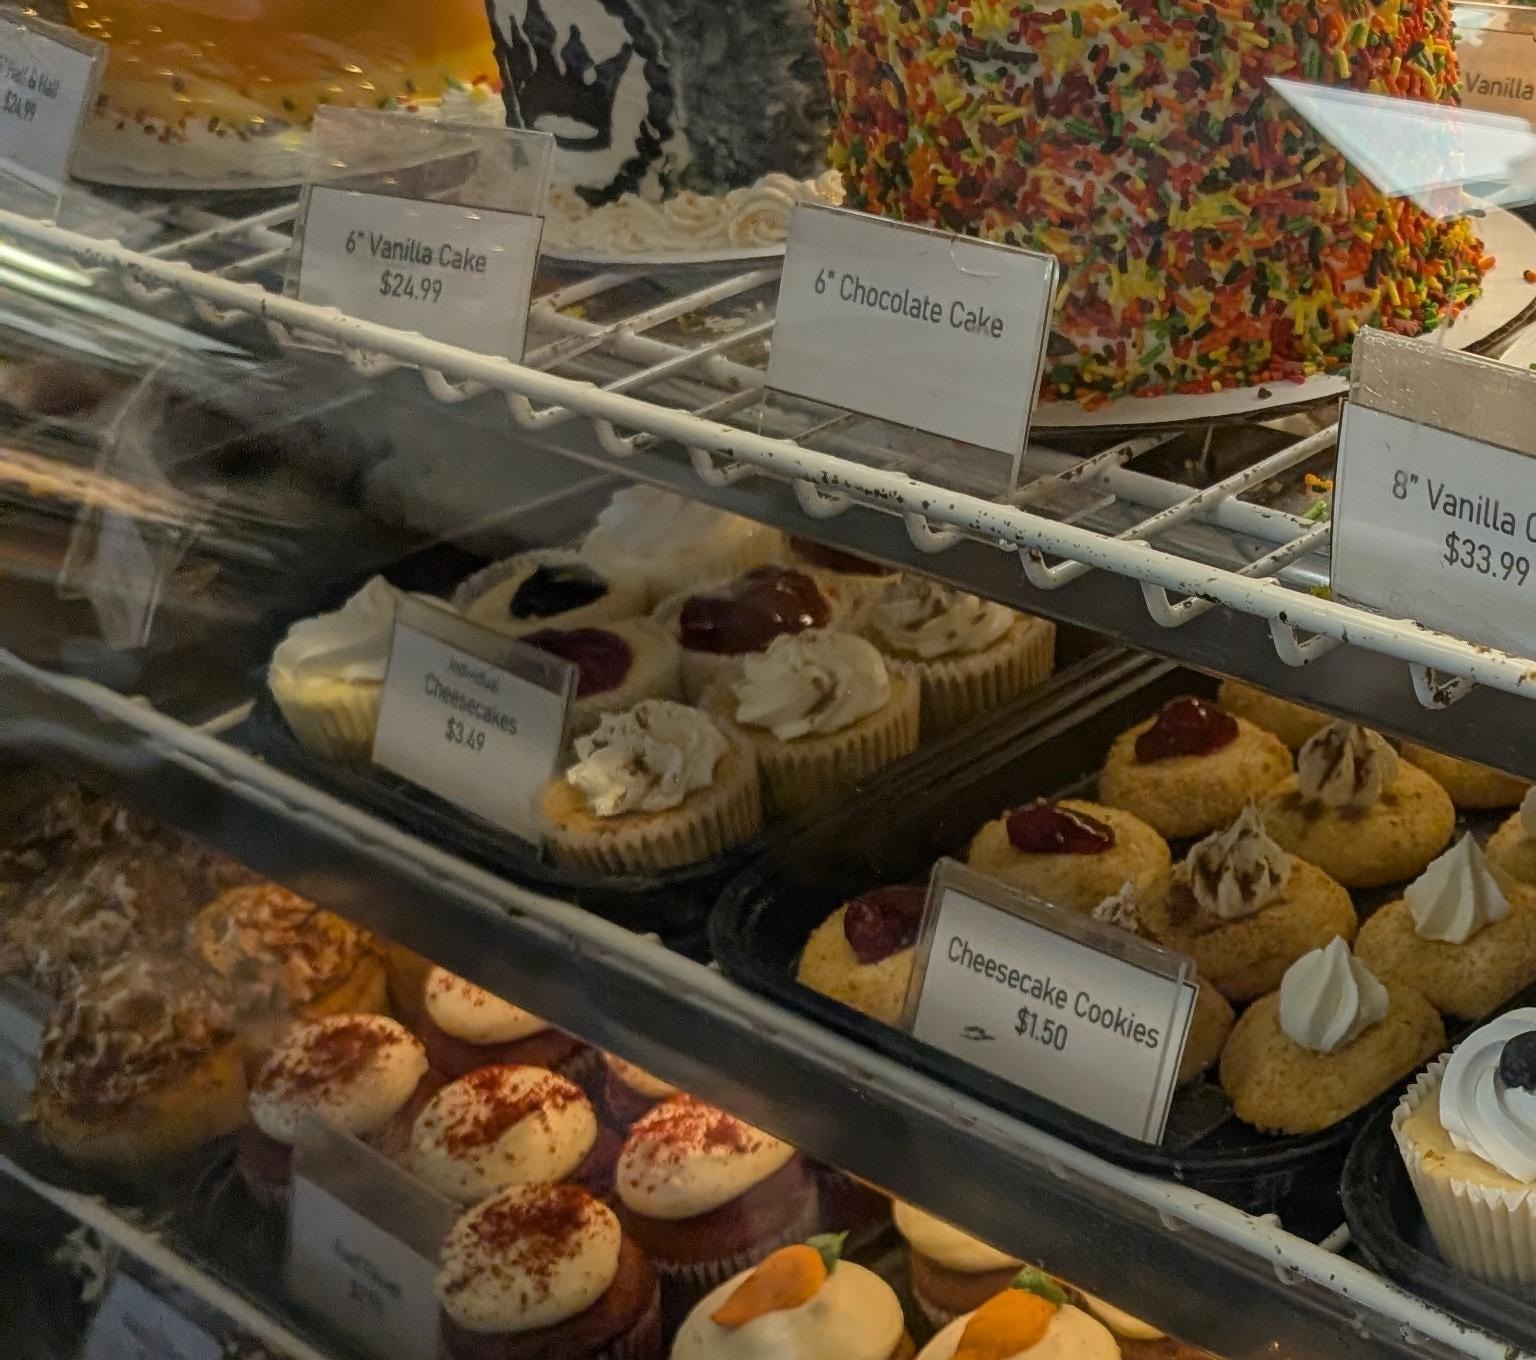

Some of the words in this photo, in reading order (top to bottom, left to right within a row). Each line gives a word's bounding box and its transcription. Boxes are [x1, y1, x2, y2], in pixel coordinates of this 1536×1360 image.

[1465, 71, 1535, 100] Vanilla
[345, 229, 365, 254] 6"
[369, 232, 433, 267] Vanilla
[437, 244, 488, 274] Cake
[379, 270, 442, 304] $24.99
[814, 267, 835, 295] 6"
[840, 273, 943, 324] Chocolate
[949, 301, 1004, 339] Cake
[1391, 469, 1419, 500] 8"
[1427, 478, 1516, 538] Vanilla
[1443, 530, 1530, 586] $33.99
[424, 672, 517, 735] Cheesecakes
[948, 935, 1068, 1010] Cheesecake
[1073, 990, 1160, 1049] Cookies
[1014, 1005, 1068, 1052] $1.50
